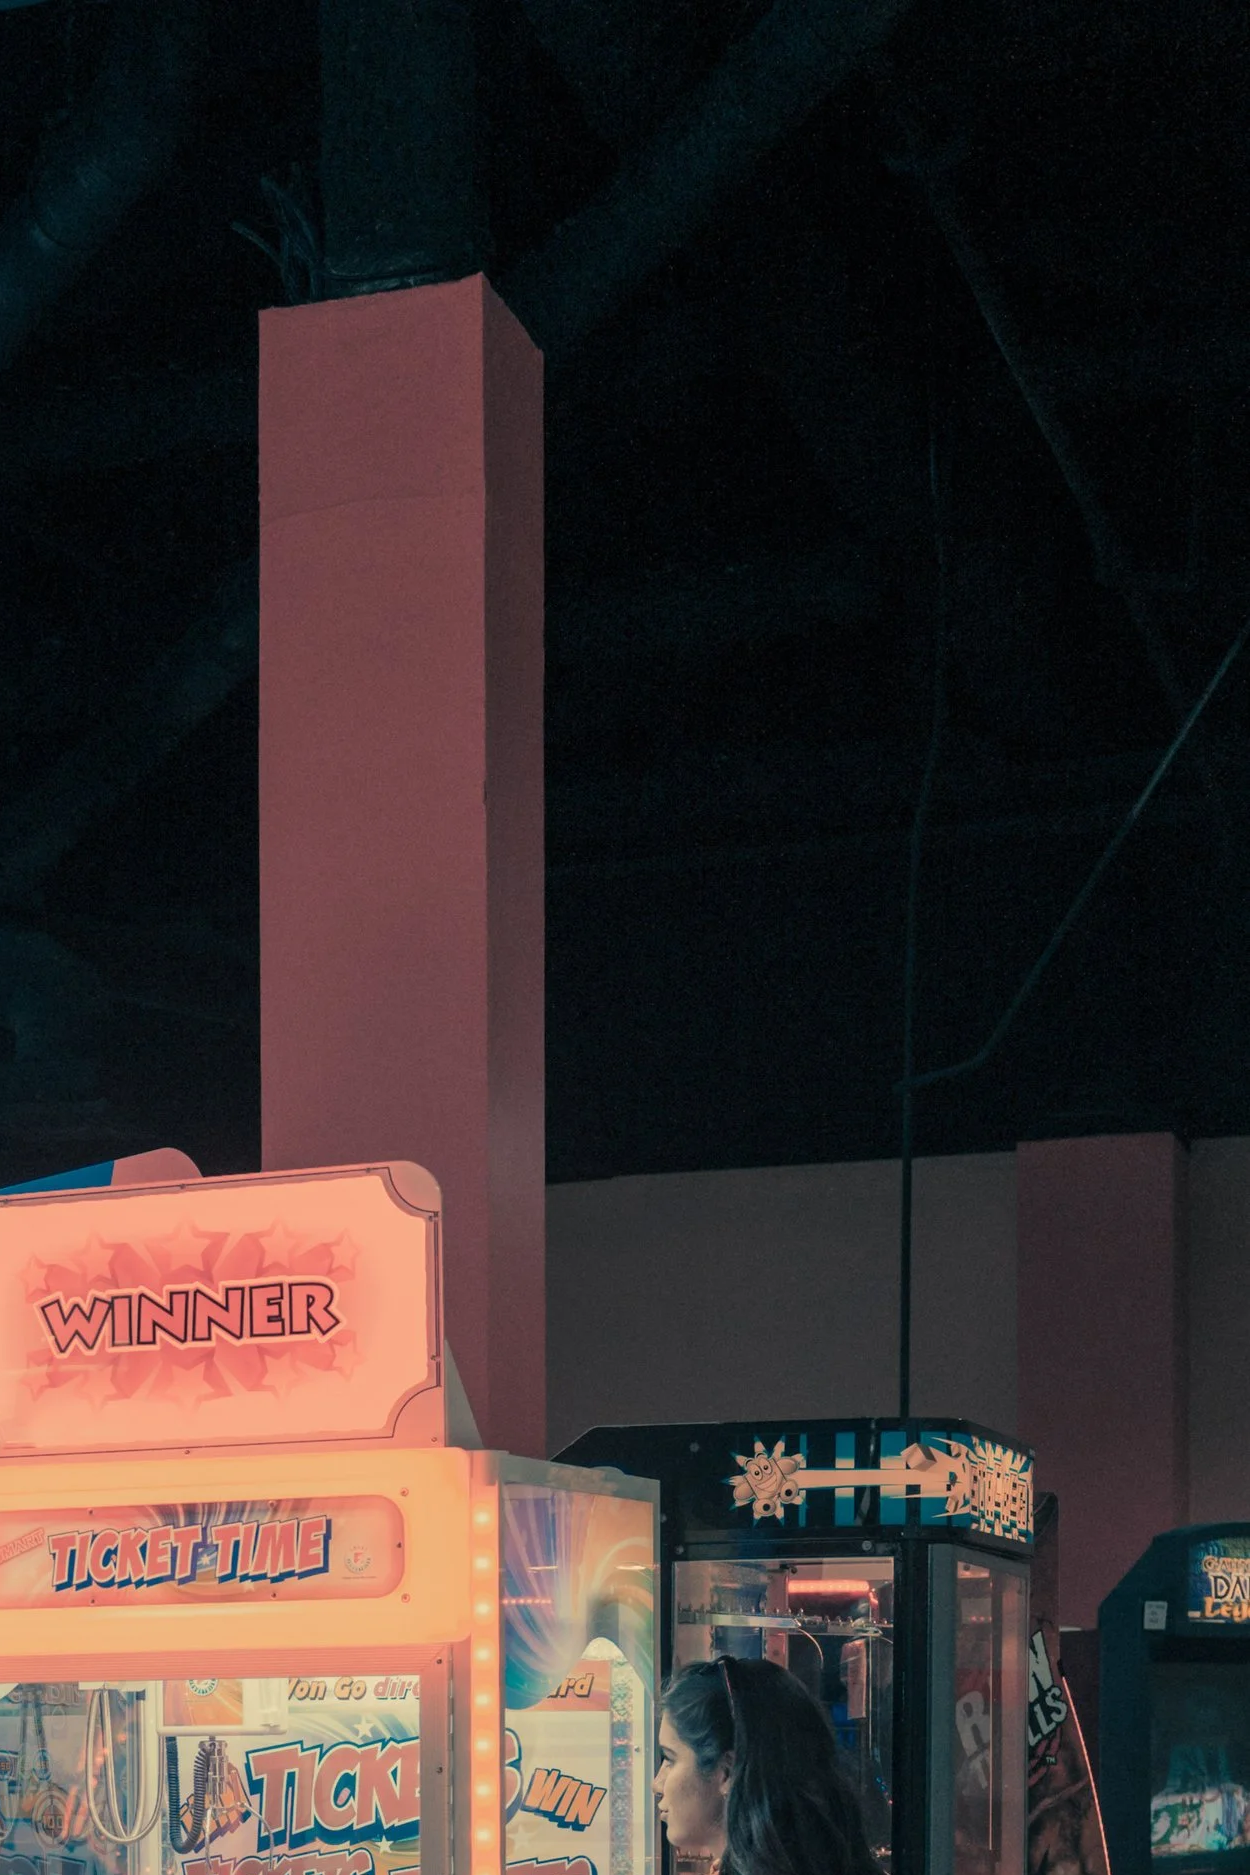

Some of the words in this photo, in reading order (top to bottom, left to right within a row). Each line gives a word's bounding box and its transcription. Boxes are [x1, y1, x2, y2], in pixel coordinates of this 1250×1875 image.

[39, 1280, 342, 1355] WINNER
[48, 1524, 204, 1591] TICKET
[212, 1515, 332, 1584] TIME
[334, 1677, 367, 1700] Go
[520, 1768, 607, 1832] WIN
